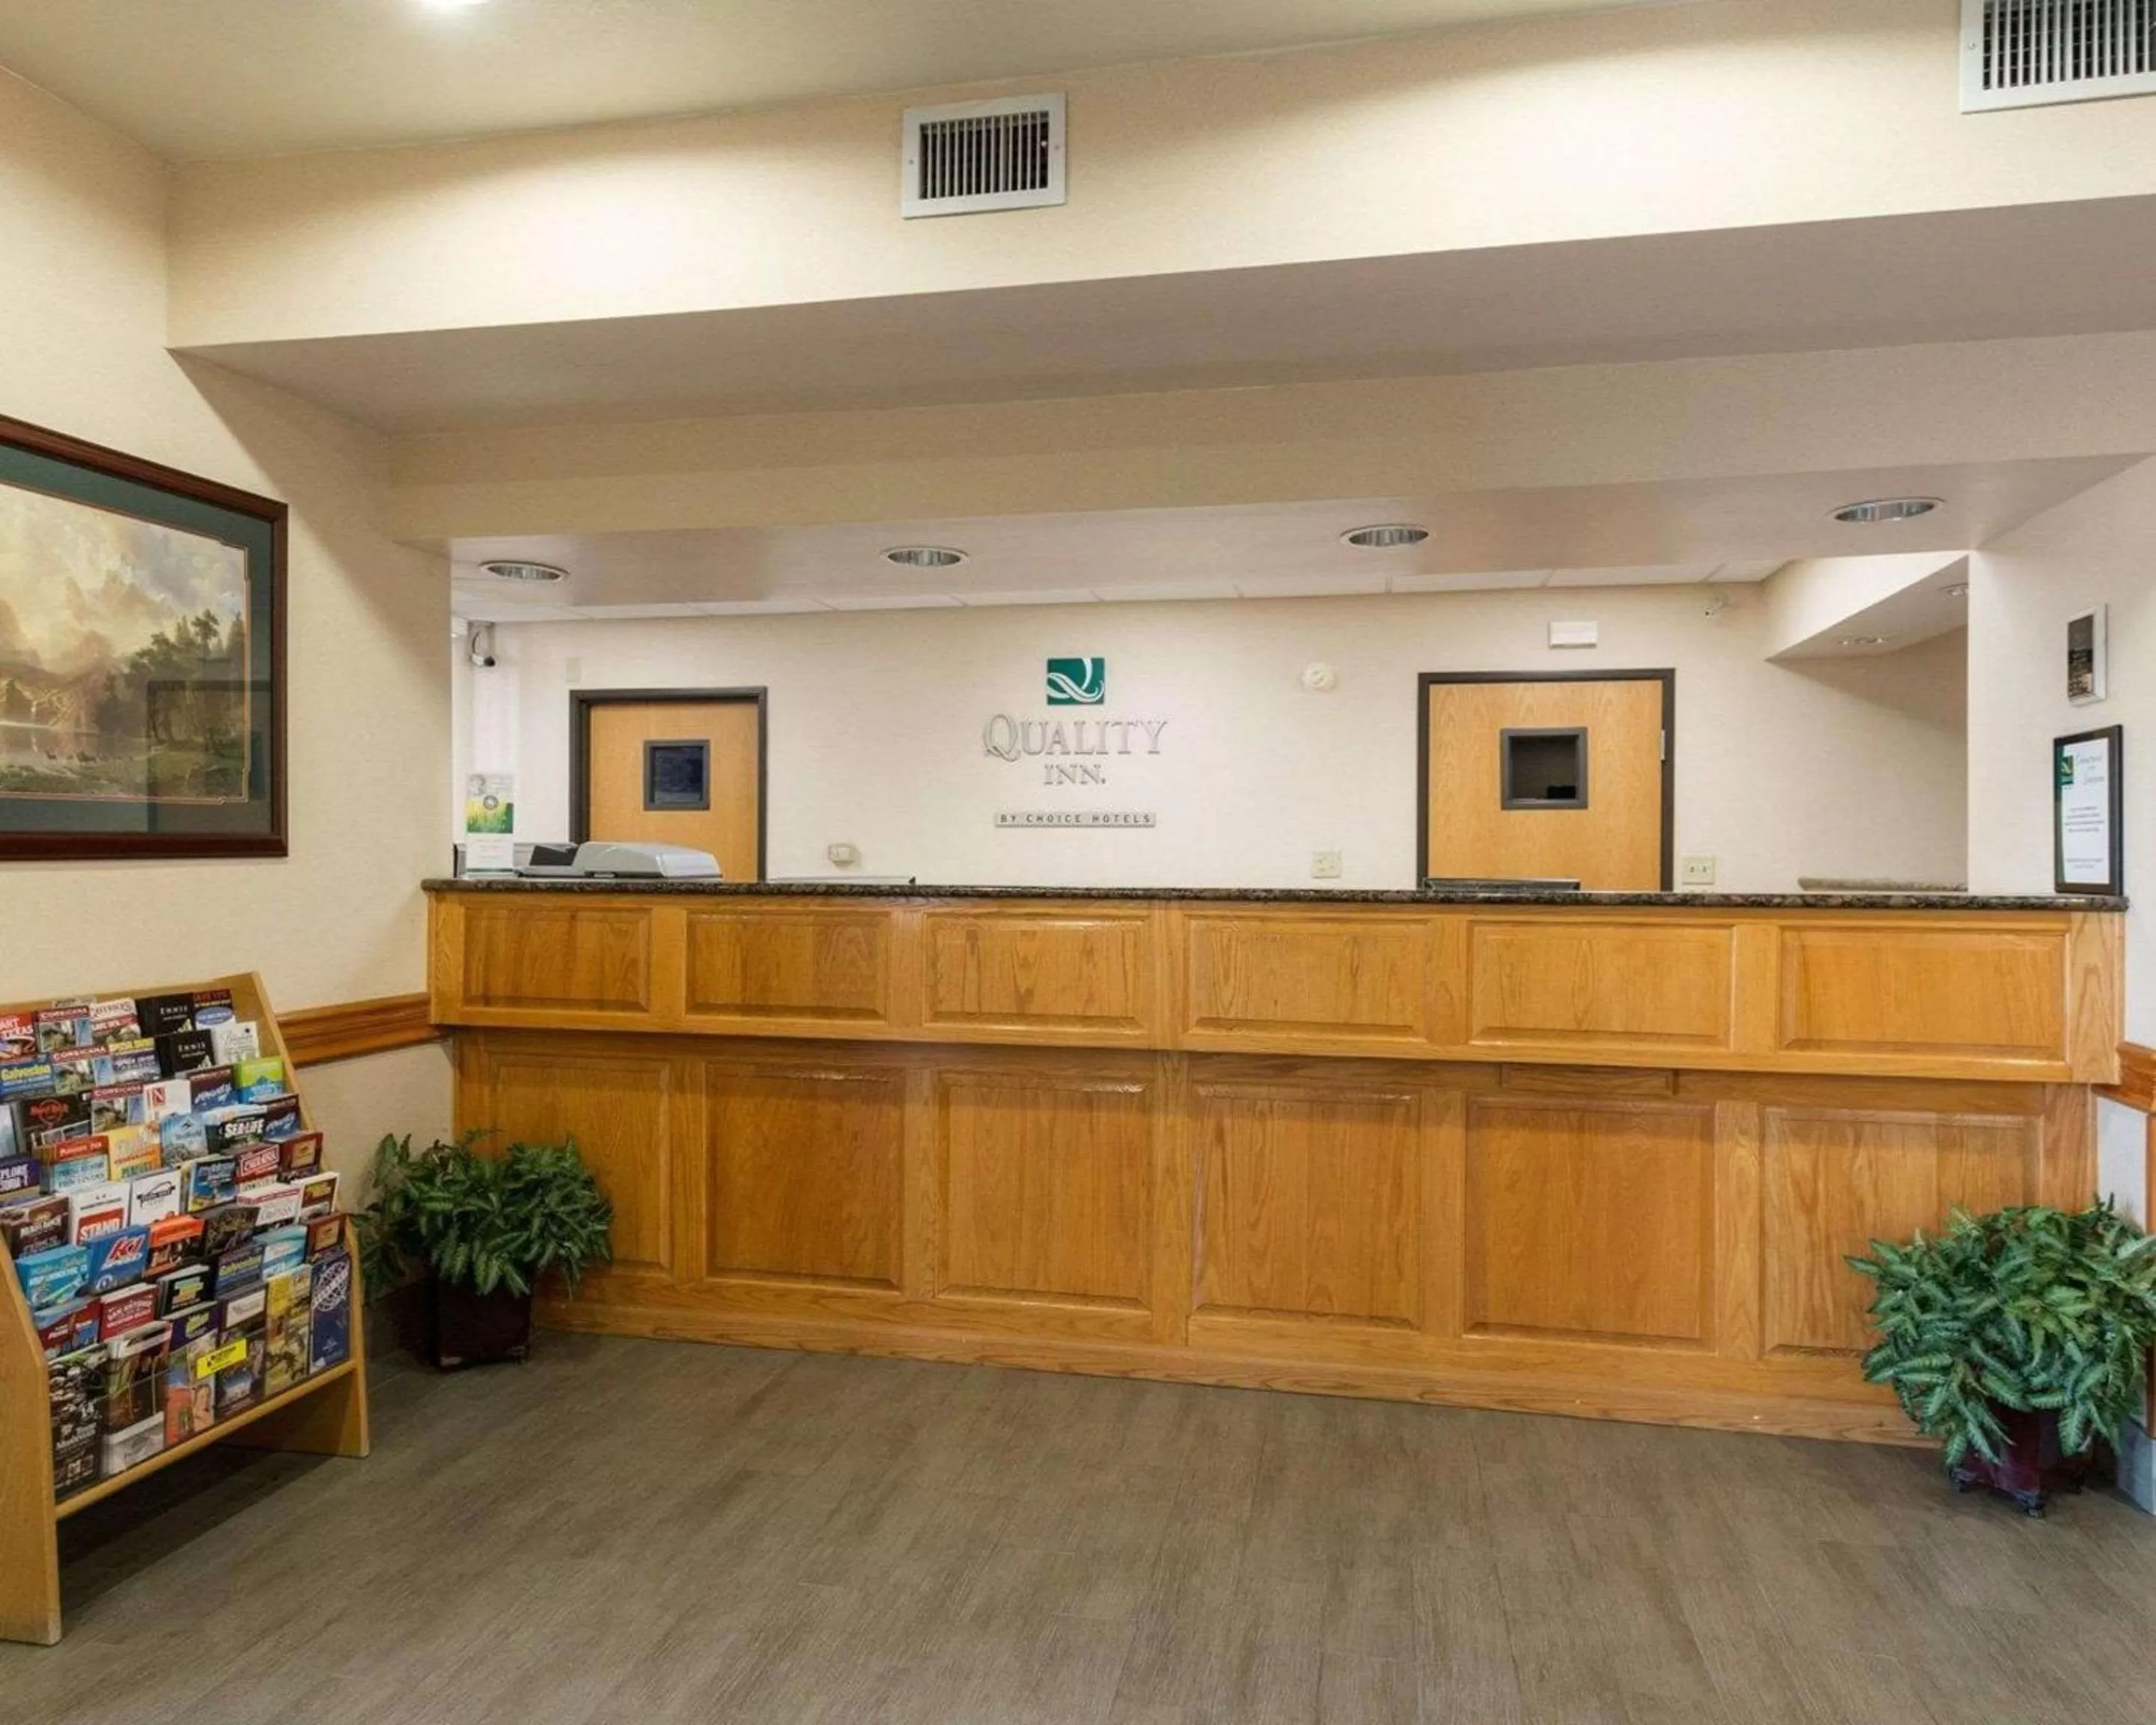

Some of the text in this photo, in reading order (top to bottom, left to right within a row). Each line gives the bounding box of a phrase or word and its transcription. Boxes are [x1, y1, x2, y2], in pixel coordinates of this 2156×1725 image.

[983, 714, 1168, 762] QUALITY
[999, 814, 1151, 824] BY CHOICE HOTELS
